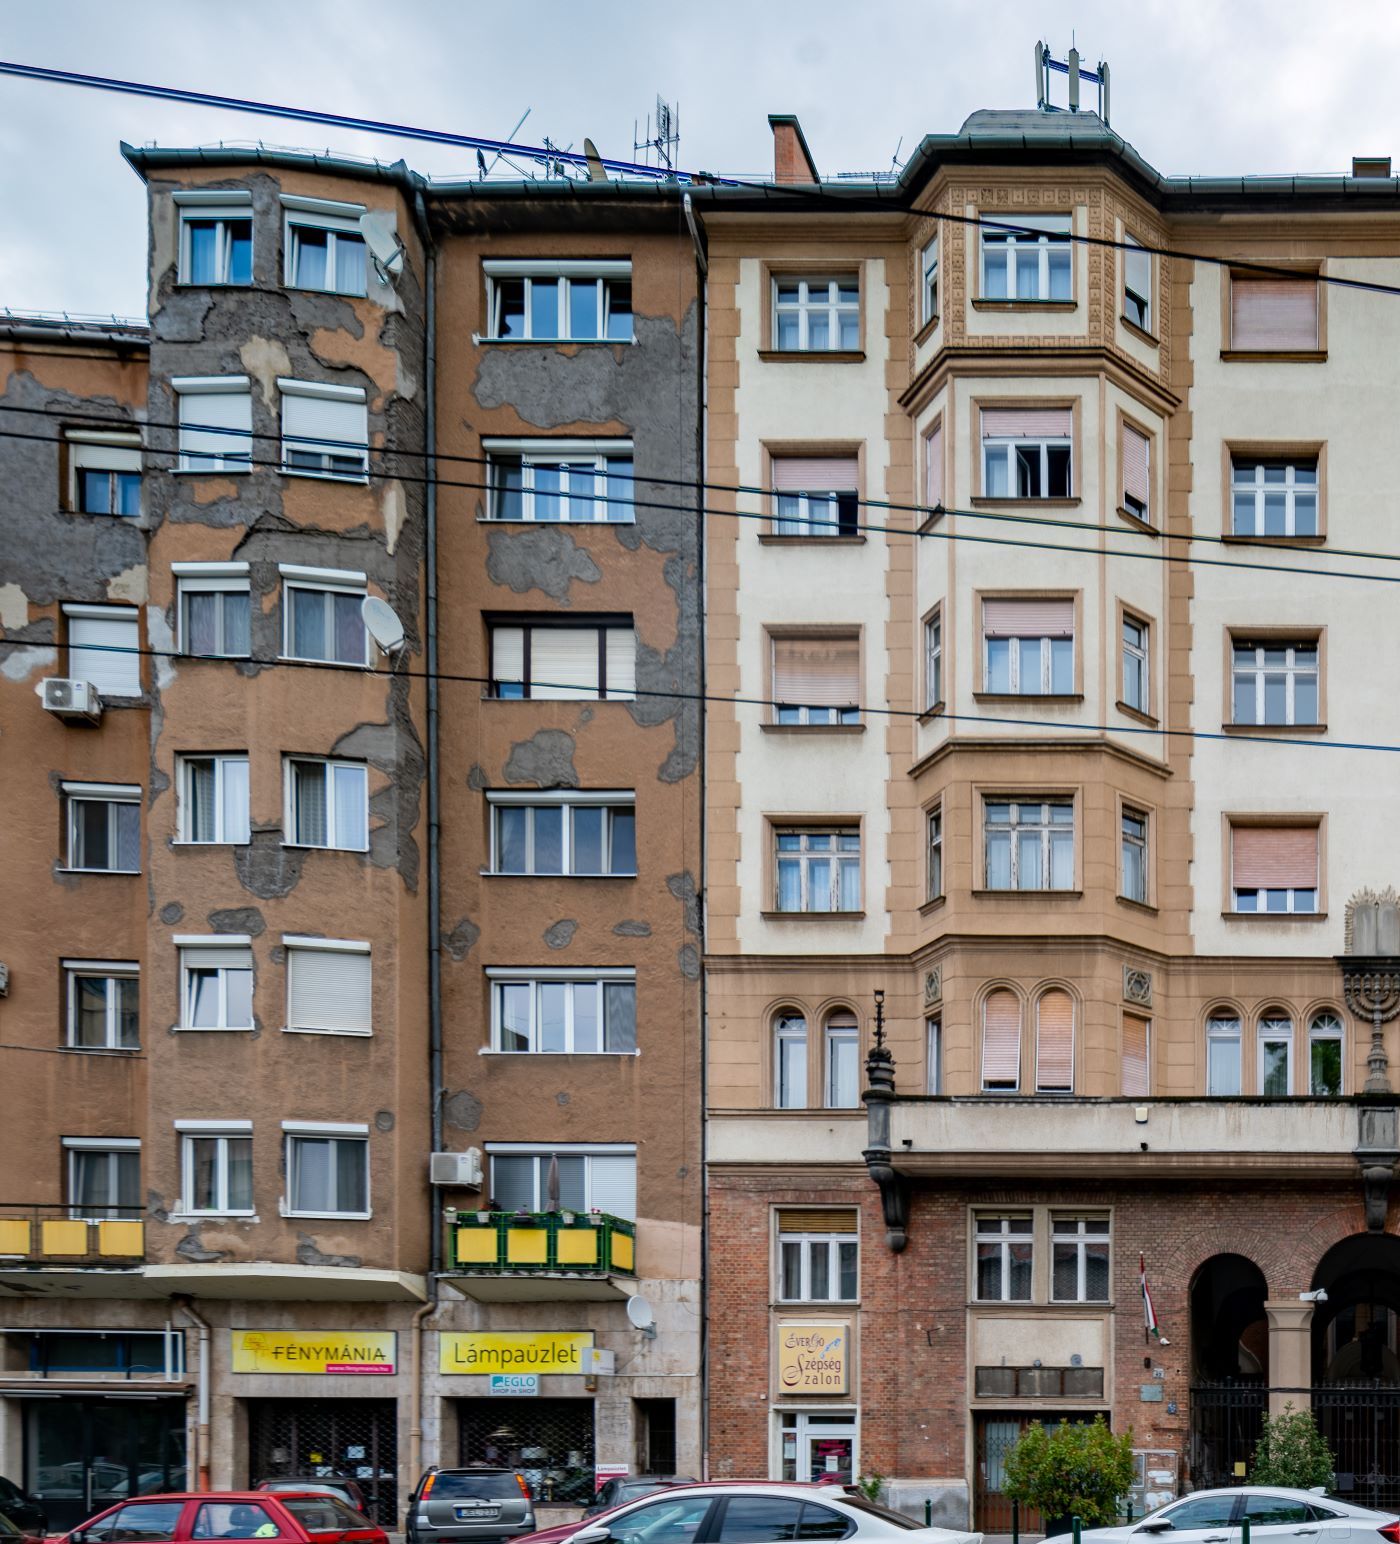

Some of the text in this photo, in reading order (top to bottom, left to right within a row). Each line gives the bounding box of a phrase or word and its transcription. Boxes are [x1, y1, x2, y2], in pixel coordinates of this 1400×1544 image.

[271, 1344, 386, 1361] FÉNYMÁNIA
[454, 1342, 577, 1369] Lámpaüzlet
[504, 1376, 536, 1387] EGLO
